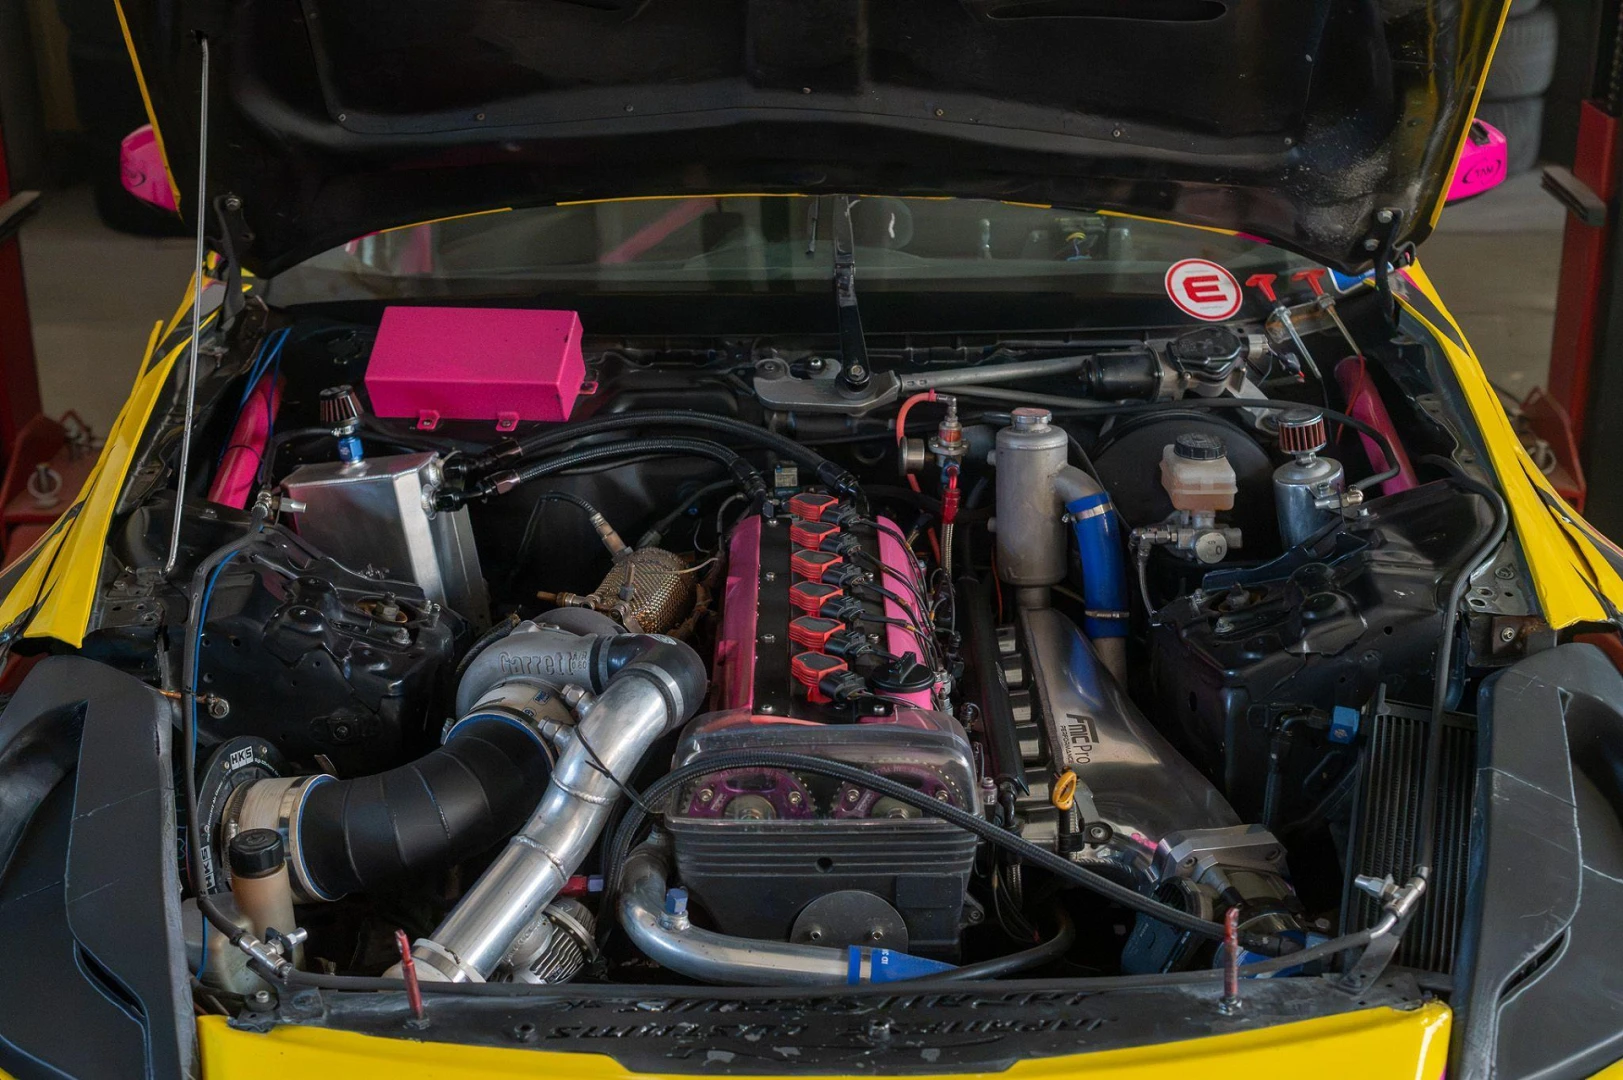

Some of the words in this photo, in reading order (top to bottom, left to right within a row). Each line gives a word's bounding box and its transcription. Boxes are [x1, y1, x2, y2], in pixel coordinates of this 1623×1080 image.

[499, 651, 573, 675] Garrett
[230, 747, 253, 766] HKS
[200, 847, 214, 888] HKS
